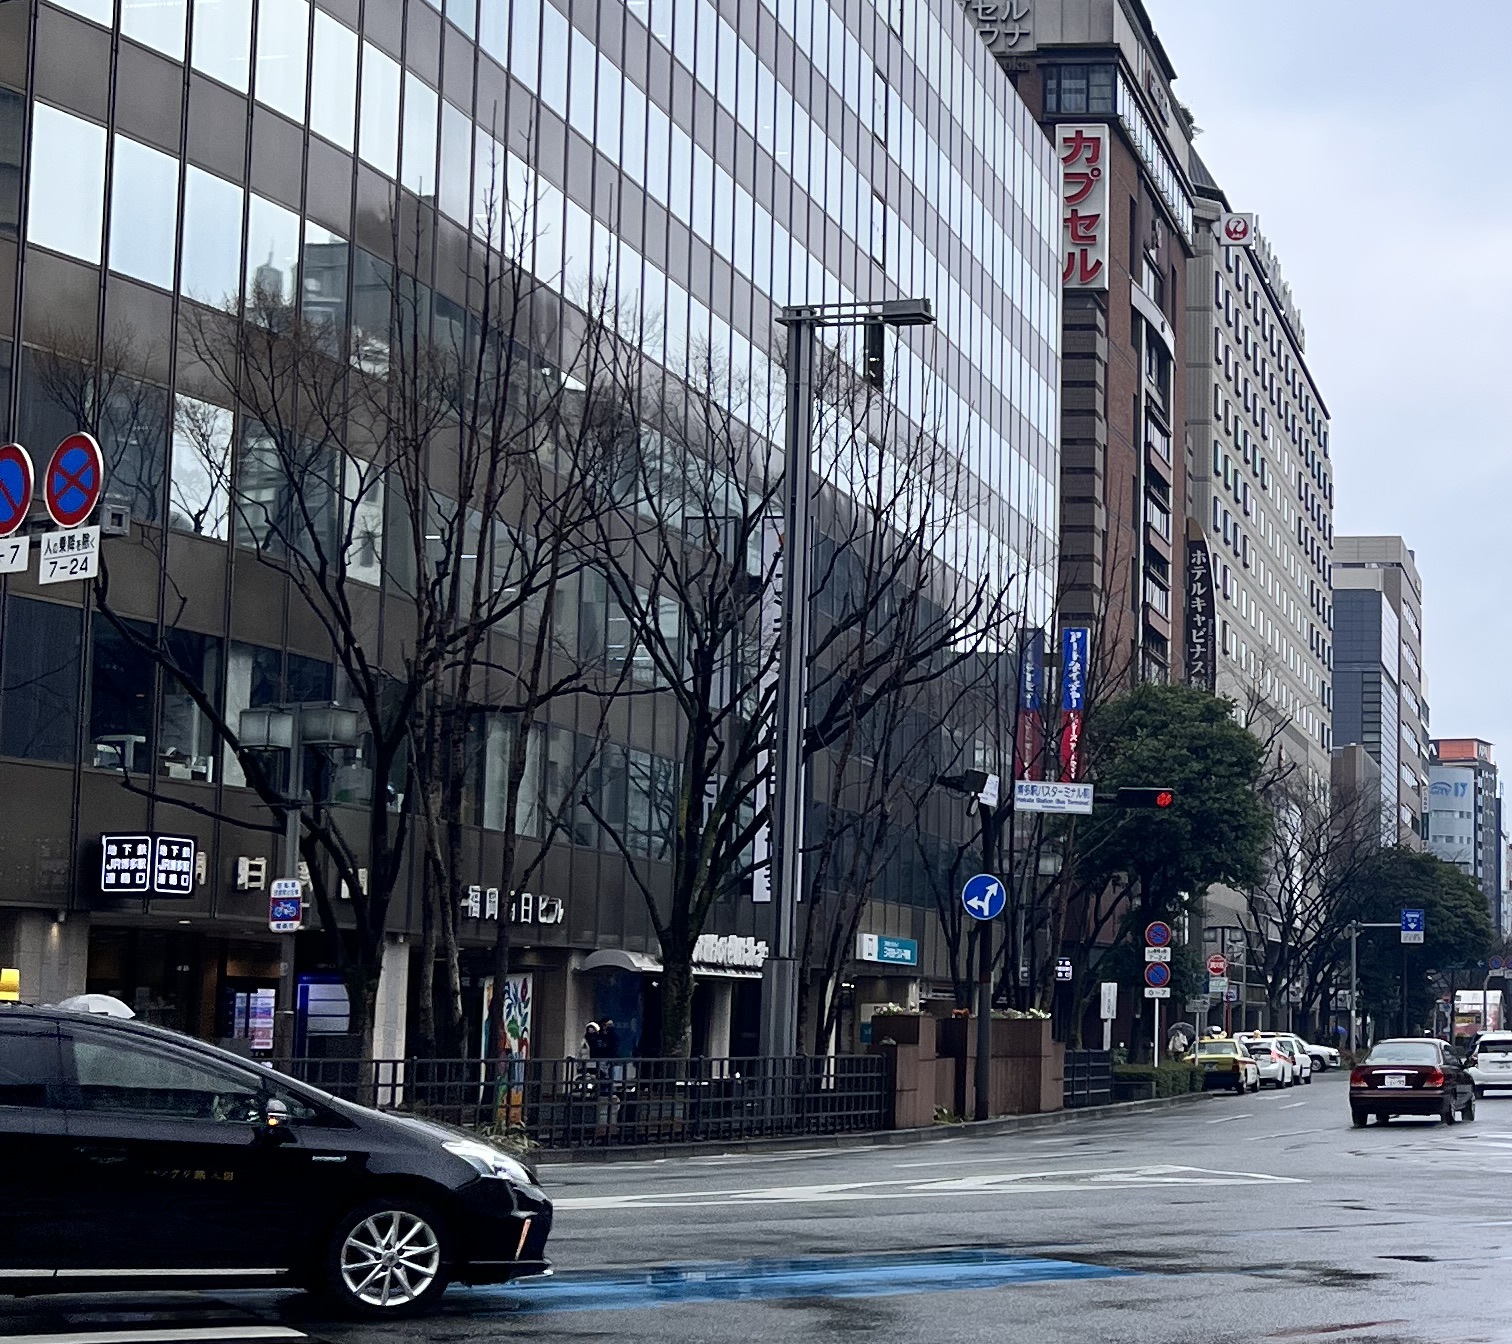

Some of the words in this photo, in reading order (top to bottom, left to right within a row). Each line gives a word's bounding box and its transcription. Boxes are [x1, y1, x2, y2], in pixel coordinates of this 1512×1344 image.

[1061, 130, 1103, 285] カプセル
[44, 533, 96, 556] 人の乗降を除く
[49, 556, 89, 578] 7-24
